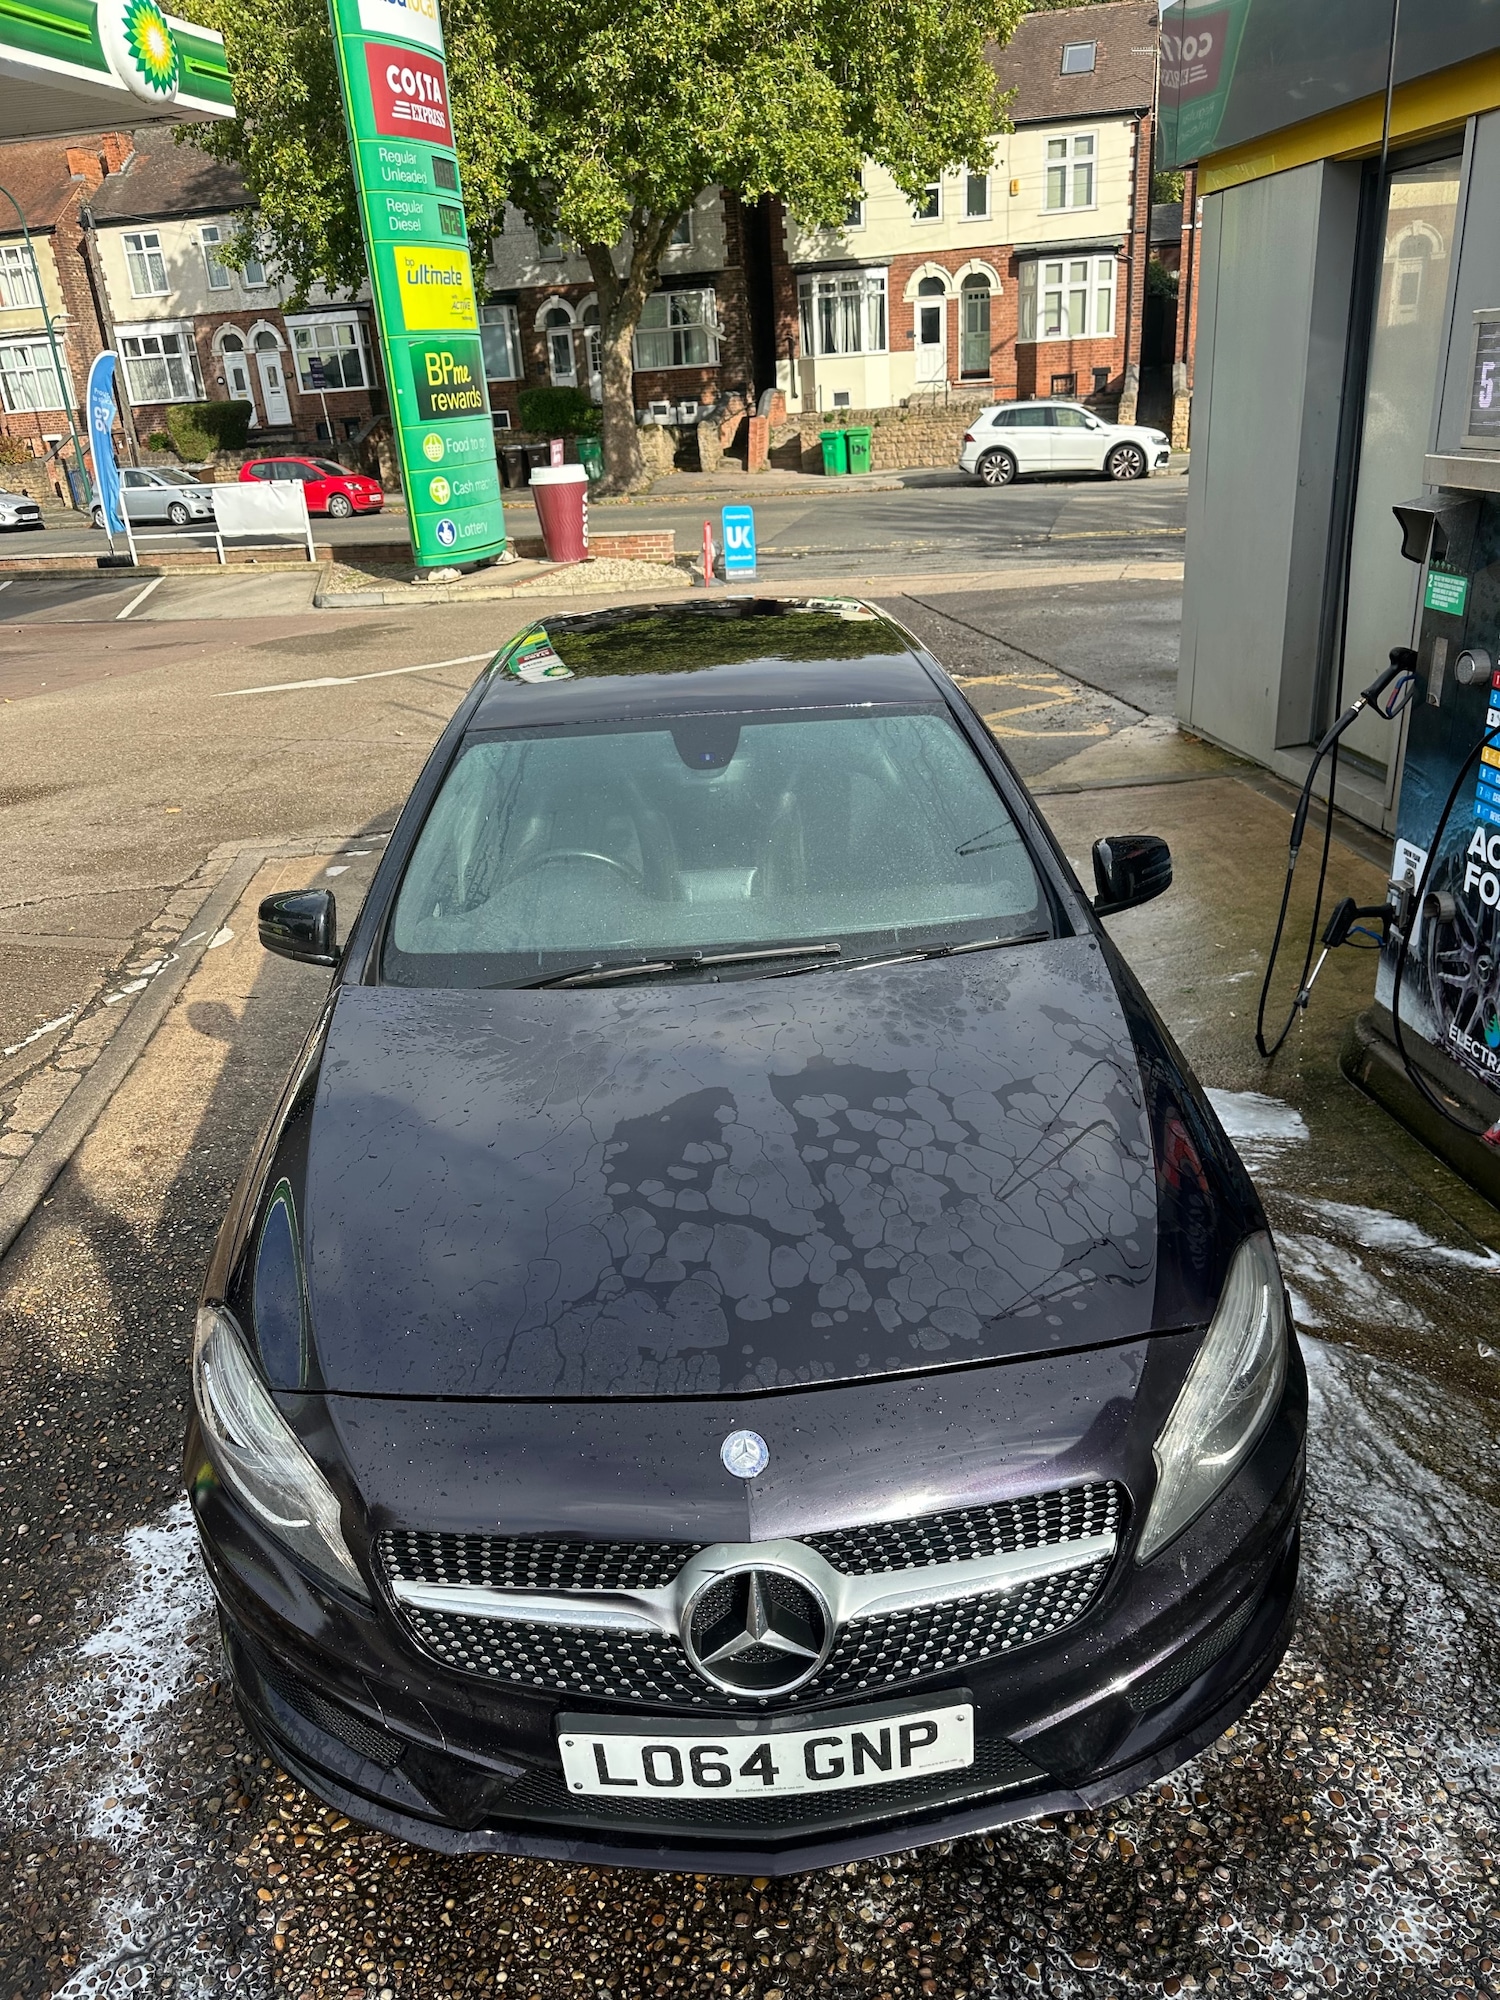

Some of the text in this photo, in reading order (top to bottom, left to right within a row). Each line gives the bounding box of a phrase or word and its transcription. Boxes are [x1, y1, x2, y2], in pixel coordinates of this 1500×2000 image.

[386, 65, 443, 105] COSTA
[410, 103, 446, 128] EXPRESS
[378, 147, 417, 166] Regular
[381, 166, 427, 185] Unleaded
[386, 197, 424, 216] Regular
[389, 216, 422, 231] Diesel
[408, 264, 462, 286] ultimate
[1479, 361, 1496, 408] 5
[430, 385, 482, 411] rewards
[446, 436, 469, 454] Food
[470, 436, 478, 450] to
[452, 479, 474, 496] Cash
[458, 520, 488, 538] Lottery
[726, 526, 752, 548] UK
[592, 1720, 938, 1788] LO64 GNP
